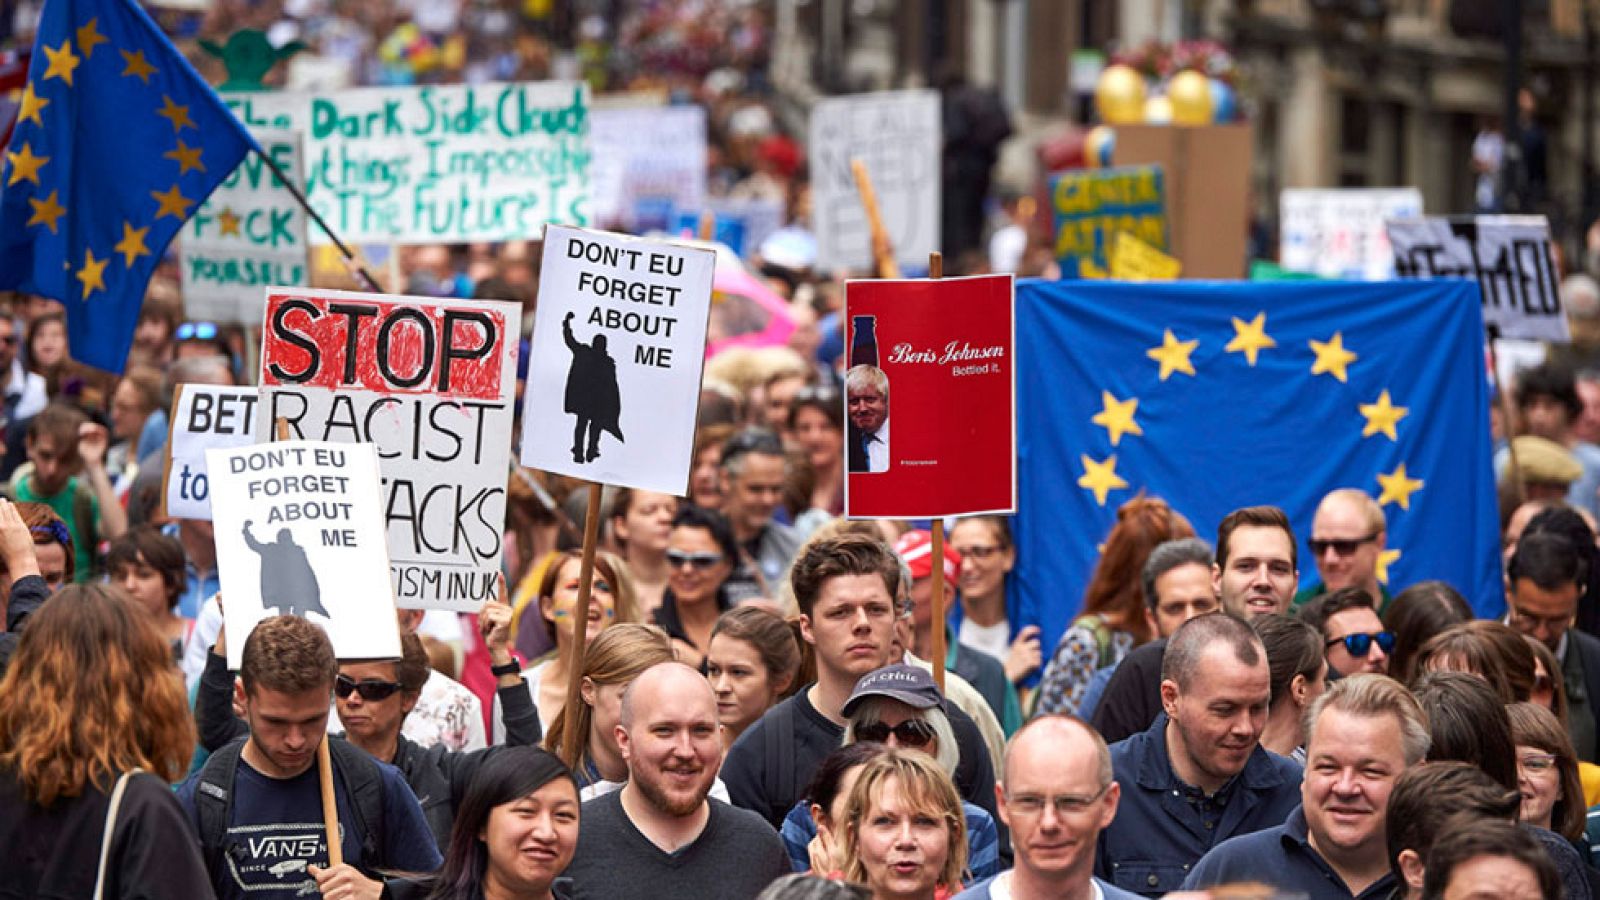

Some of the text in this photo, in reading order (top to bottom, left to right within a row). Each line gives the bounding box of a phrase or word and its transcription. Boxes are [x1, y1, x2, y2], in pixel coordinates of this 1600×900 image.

[311, 97, 403, 139] Dark
[413, 85, 490, 135] Side
[336, 190, 402, 233] The
[415, 182, 537, 240] Future
[546, 180, 588, 227] Is
[567, 238, 685, 277] DON'T EU
[577, 271, 682, 307] FORGET
[587, 306, 678, 338] ABOUT
[268, 299, 497, 392] STOP
[634, 344, 673, 369] ME
[888, 340, 1004, 365] Boris Johnson
[952, 363, 989, 377] Bottled
[271, 390, 506, 465] RACIST
[229, 447, 346, 475] DON'T EU
[247, 474, 350, 500] FORGET
[267, 501, 353, 524] ABOUT
[382, 477, 505, 568] ACKS
[321, 528, 357, 548] ME
[390, 566, 442, 601] ISM
[880, 670, 918, 683] critic
[248, 834, 320, 859] VANS
